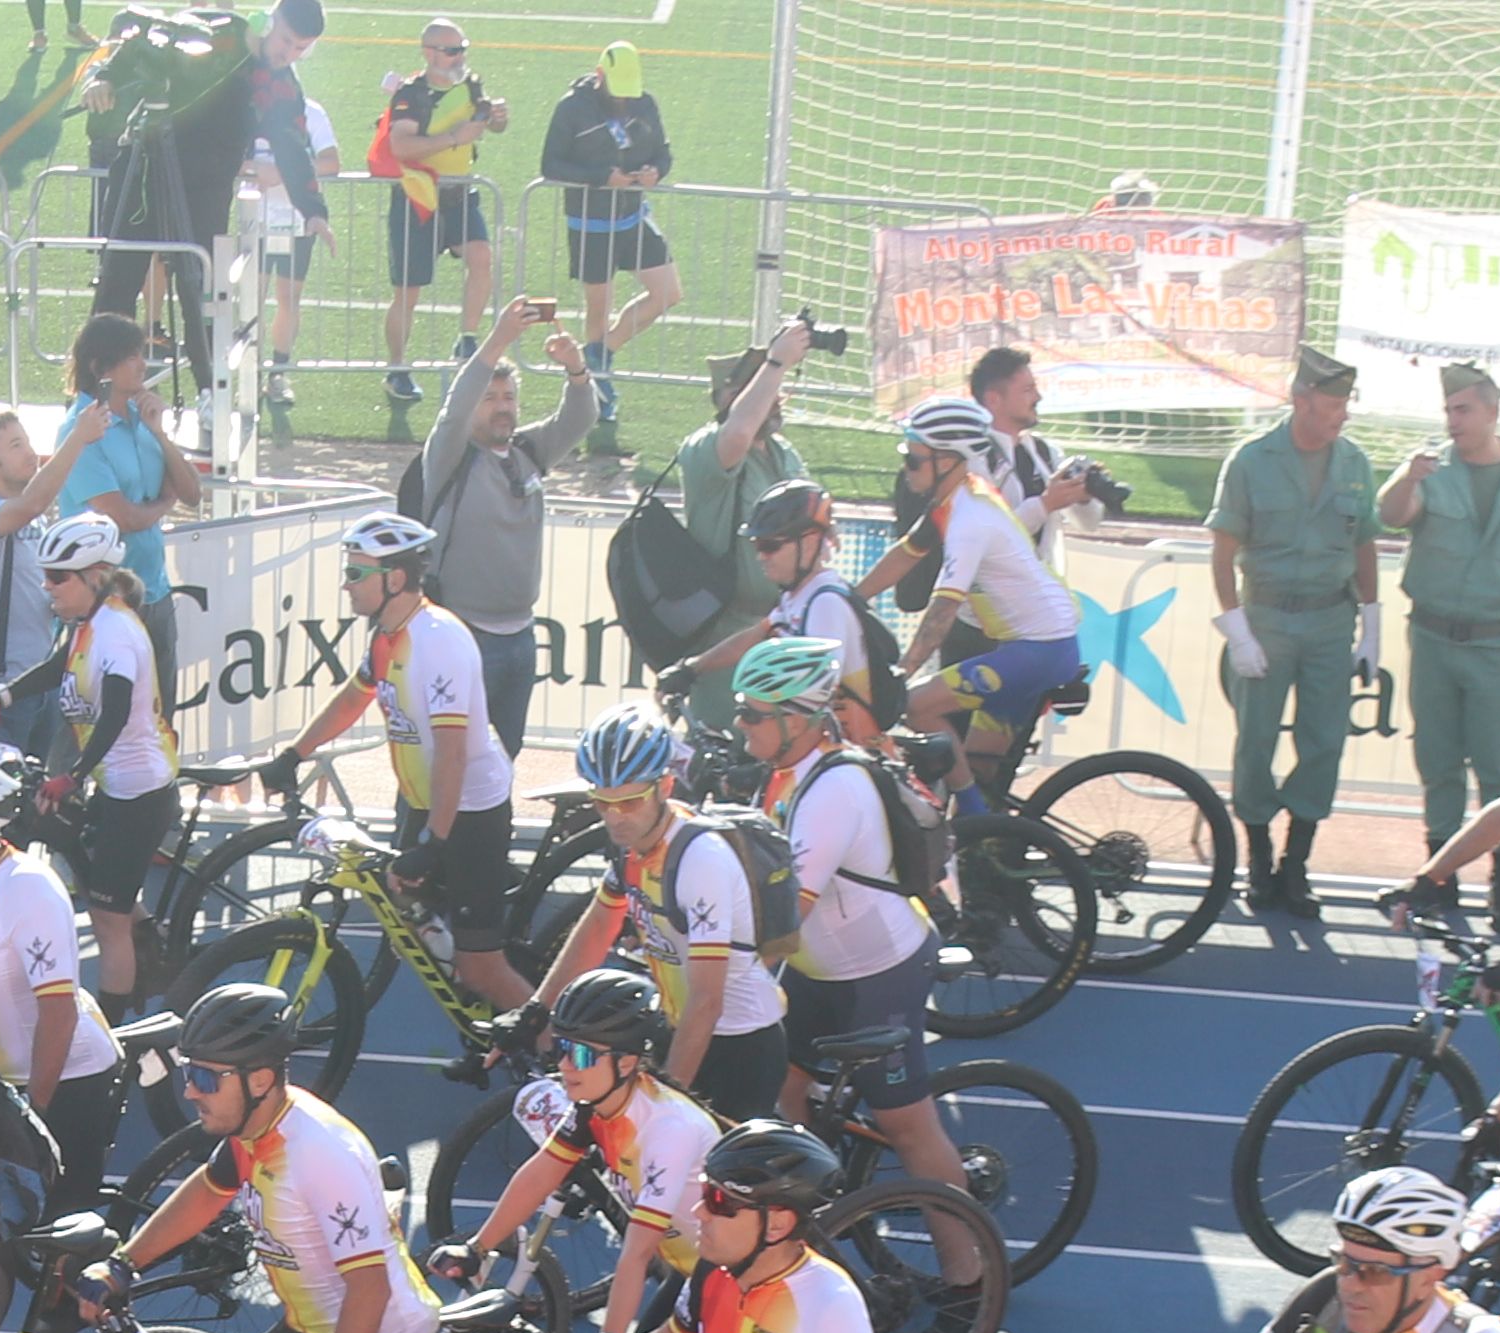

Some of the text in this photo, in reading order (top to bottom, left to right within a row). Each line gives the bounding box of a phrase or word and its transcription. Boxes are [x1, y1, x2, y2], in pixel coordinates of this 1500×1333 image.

[923, 229, 1237, 265] Alojamiento Rural
[893, 280, 1041, 336] Monte
[1142, 281, 1280, 332] Viñas
